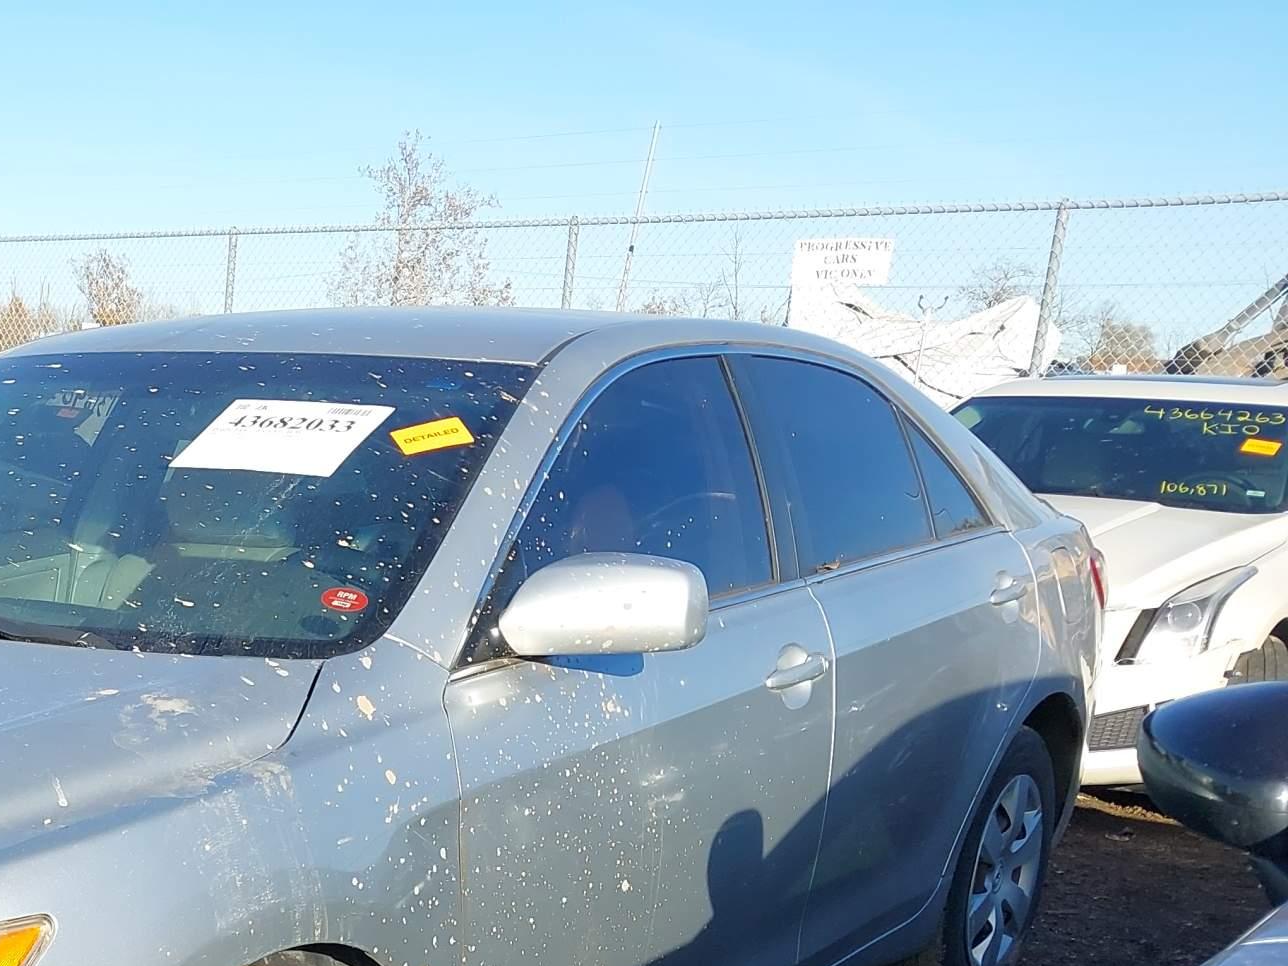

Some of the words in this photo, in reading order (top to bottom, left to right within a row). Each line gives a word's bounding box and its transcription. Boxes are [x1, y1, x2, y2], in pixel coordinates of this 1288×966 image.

[799, 240, 891, 252] PROGRESSIVE
[823, 253, 858, 265] CARS
[1143, 405, 1287, 425] 43664263
[228, 414, 357, 433] 43682033
[403, 427, 460, 445] DETAILED
[1160, 480, 1228, 496] 106,871
[336, 590, 358, 601] RPM
